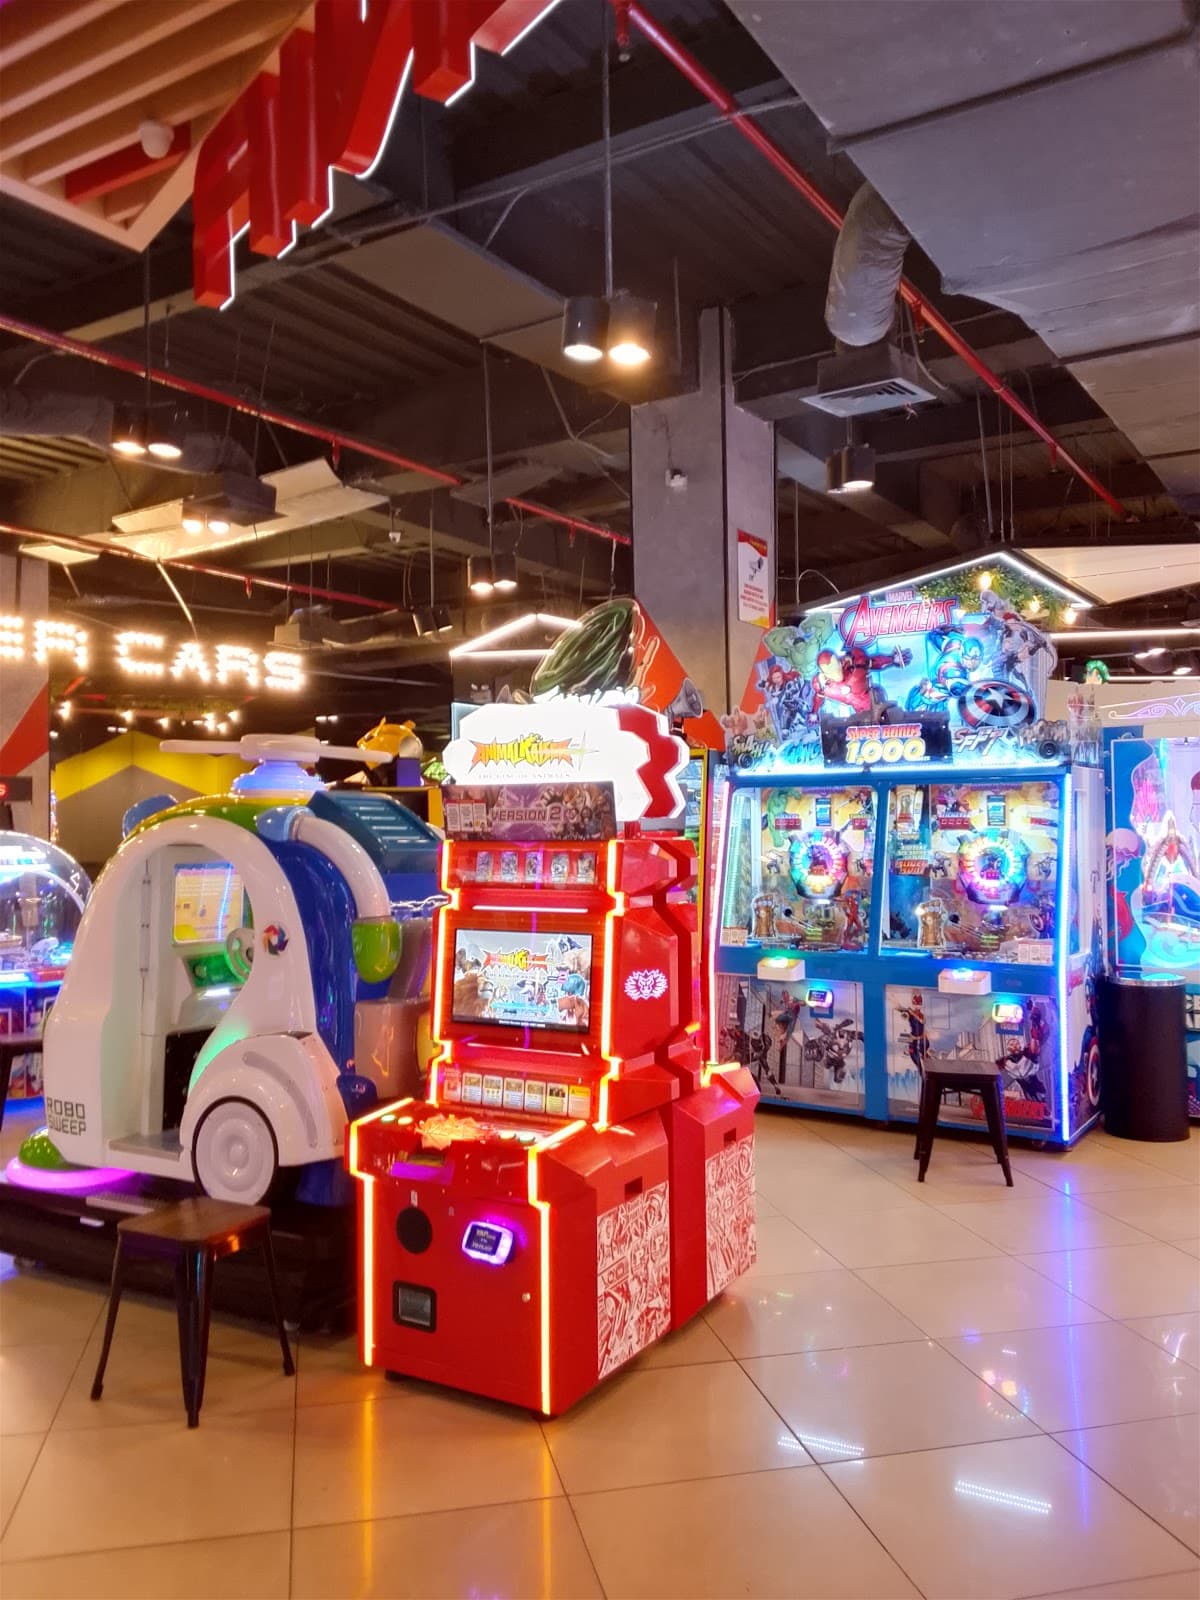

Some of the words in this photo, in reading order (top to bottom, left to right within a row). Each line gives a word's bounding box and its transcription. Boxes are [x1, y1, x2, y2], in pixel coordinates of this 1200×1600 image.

[887, 590, 915, 602] MARVEL
[840, 595, 957, 648] AVENGERS
[114, 630, 305, 690] CARS
[847, 726, 880, 741] SUPER
[881, 723, 922, 738] BONUS
[846, 738, 926, 765] 1,000
[490, 809, 547, 823] VERSION
[550, 806, 562, 820] 2
[46, 1096, 86, 1120] ROBO
[48, 1114, 87, 1136] SWEEP
